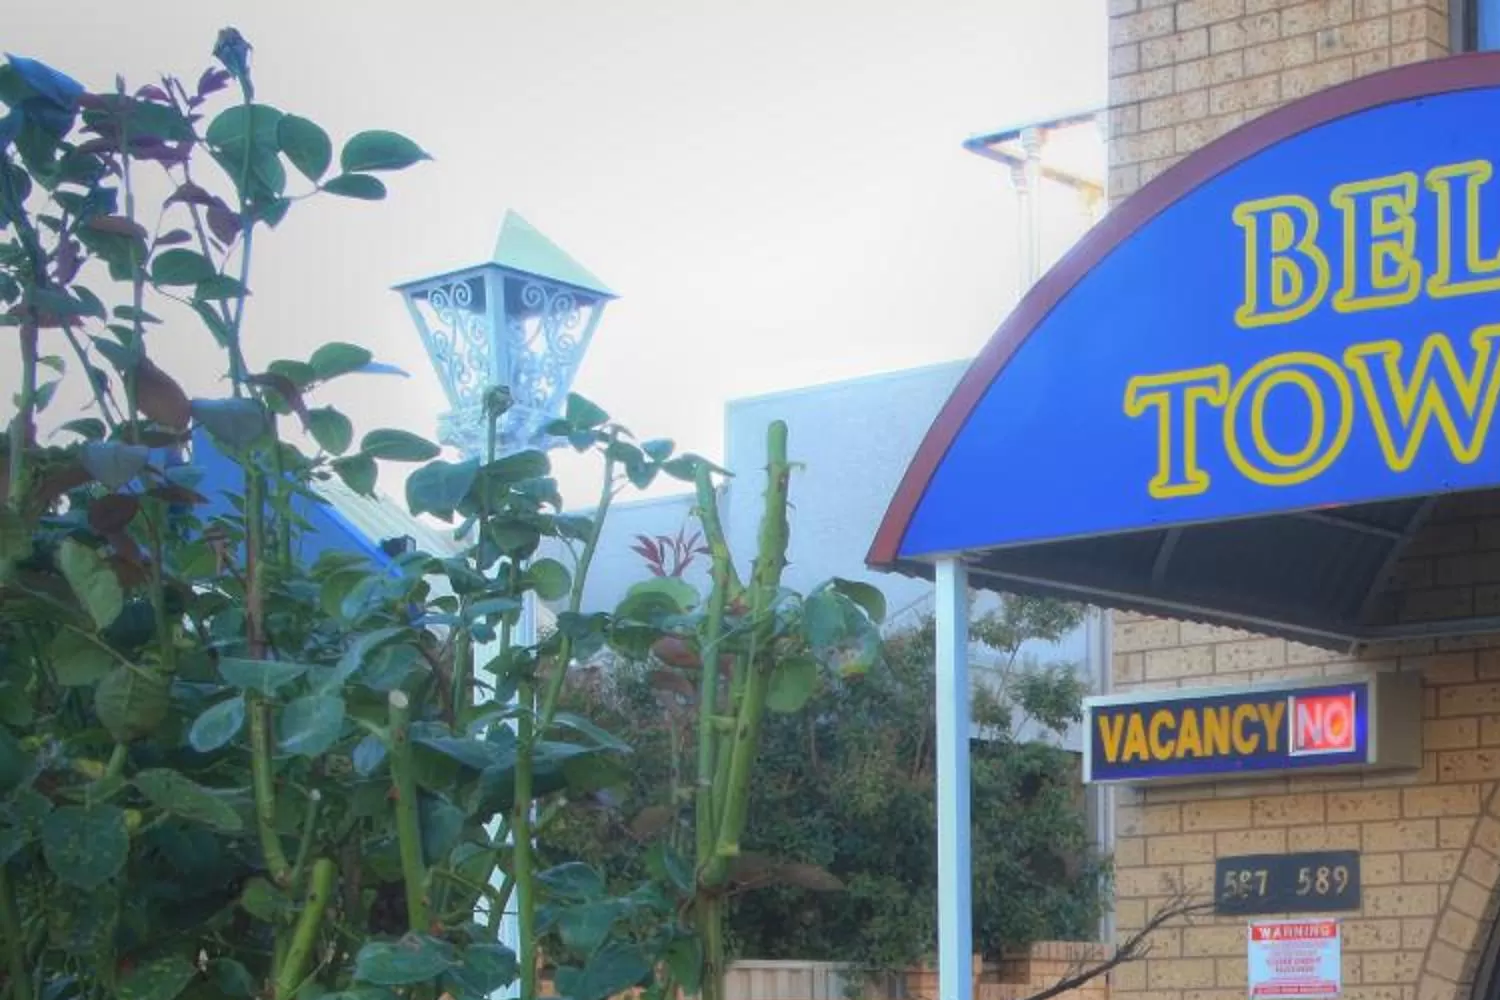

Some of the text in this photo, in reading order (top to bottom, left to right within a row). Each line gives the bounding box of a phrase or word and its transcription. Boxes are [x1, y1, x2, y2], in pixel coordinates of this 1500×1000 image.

[1098, 700, 1352, 763] VACANCY NO
[1296, 865, 1349, 896] 589
